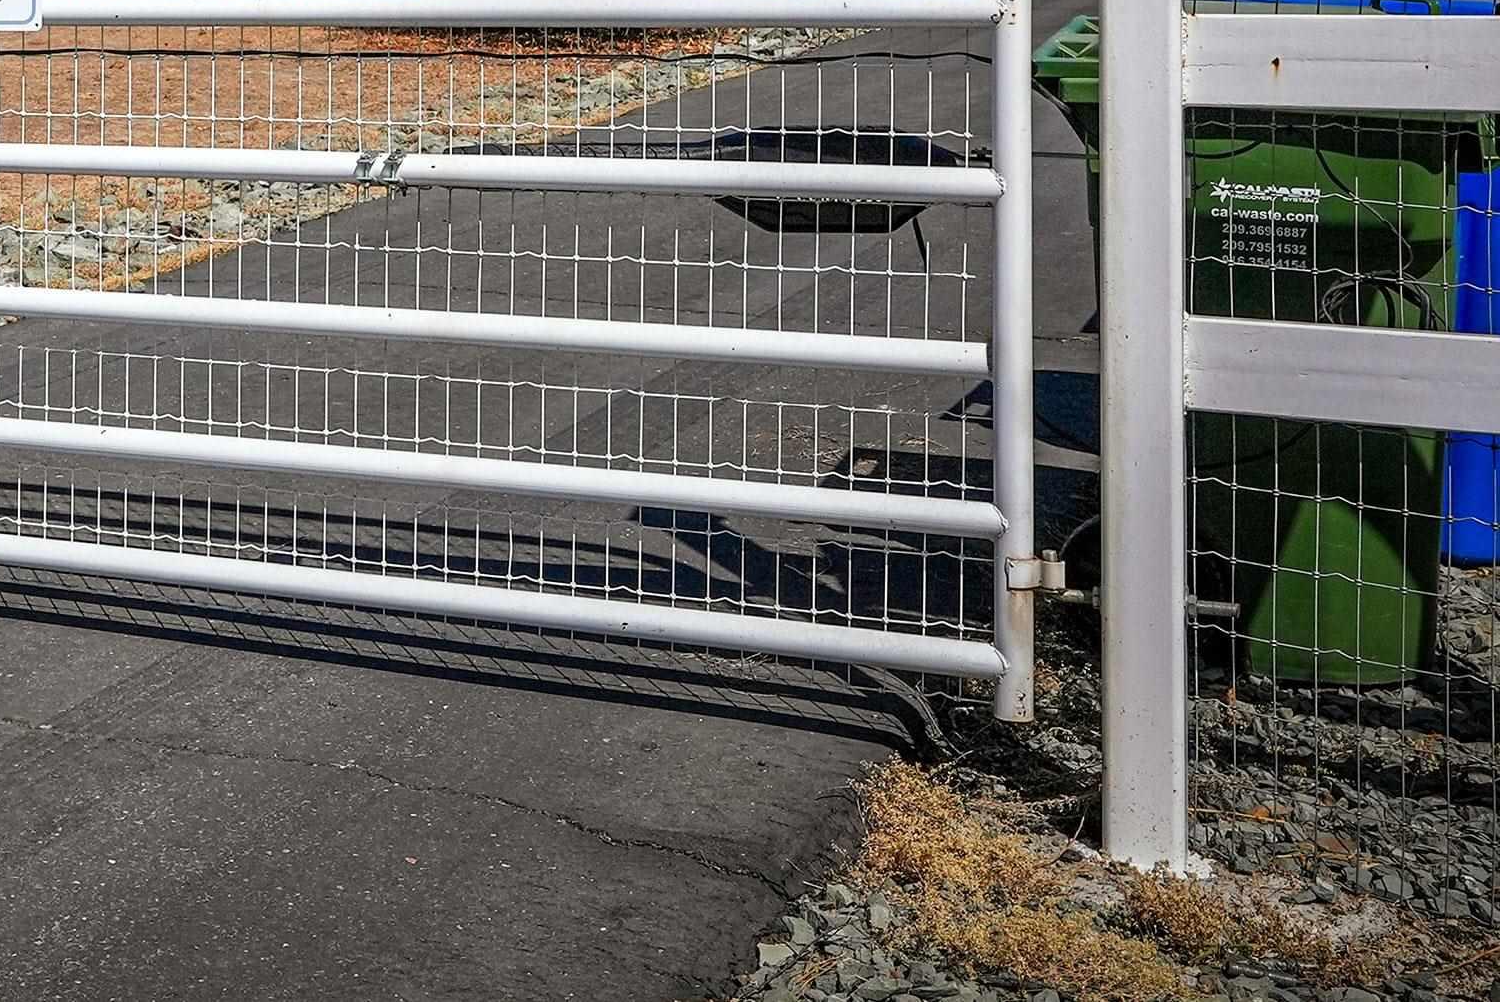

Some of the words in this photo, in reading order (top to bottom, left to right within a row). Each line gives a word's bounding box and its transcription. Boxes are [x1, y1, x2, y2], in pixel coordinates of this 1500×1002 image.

[1211, 207, 1319, 223] ca-waste.com
[1221, 223, 1308, 238] 209.3696887
[1221, 240, 1307, 255] 209.7951532
[1221, 255, 1308, 270] 963544154
